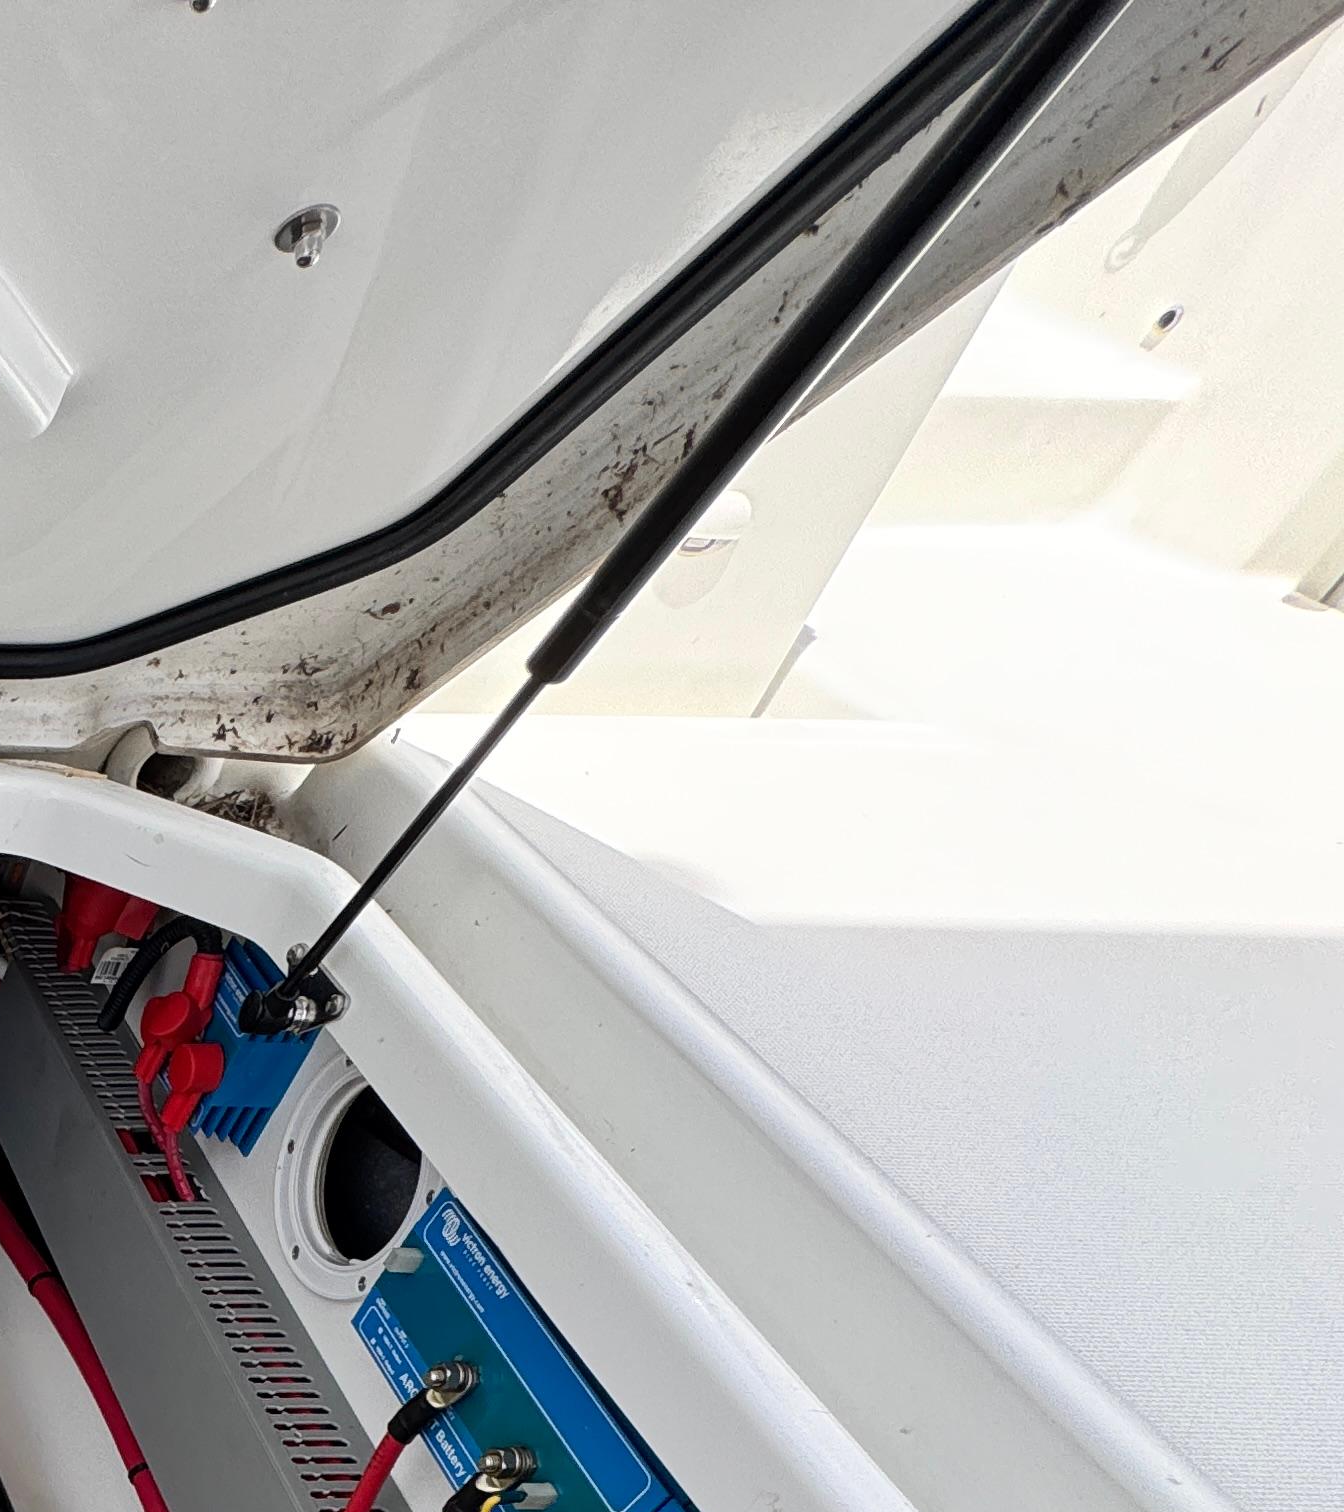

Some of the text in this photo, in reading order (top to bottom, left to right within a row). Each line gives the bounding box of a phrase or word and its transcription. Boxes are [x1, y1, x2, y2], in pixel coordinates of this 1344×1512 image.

[462, 1232, 510, 1299] victron energy
[435, 1430, 467, 1478] Battery
